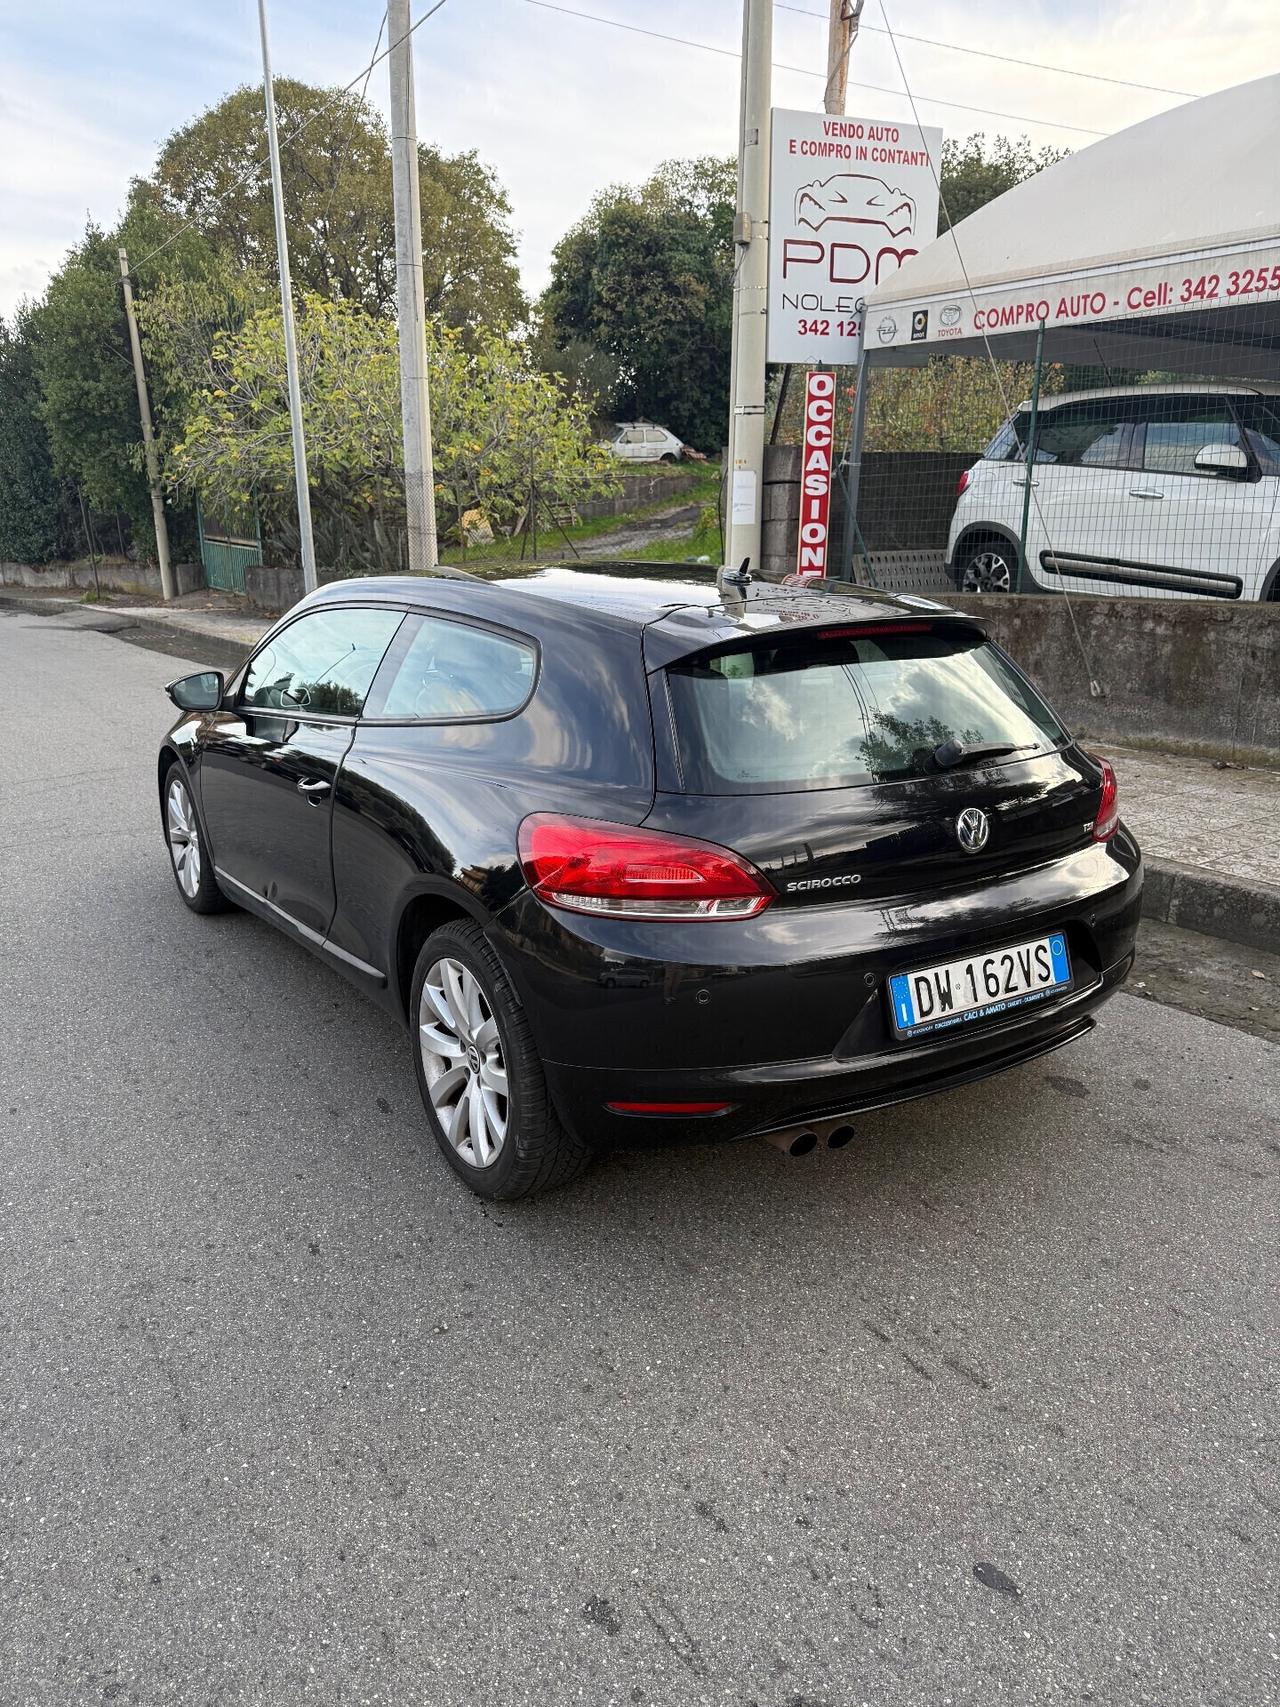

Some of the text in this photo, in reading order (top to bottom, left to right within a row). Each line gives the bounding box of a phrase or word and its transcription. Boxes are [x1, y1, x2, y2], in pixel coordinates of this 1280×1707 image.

[823, 120, 900, 143] VENDO AUTO
[789, 139, 930, 167] E COMPRO IN CONTANTI
[973, 299, 1050, 331] COMPRO
[1055, 291, 1106, 320] AUTO
[1126, 281, 1174, 311] Cell:
[1180, 273, 1220, 303] 342
[797, 319, 830, 337] 342
[938, 327, 963, 338] TOYOTA
[787, 874, 861, 893] SCIROCCO
[963, 1002, 1006, 1022] CACI & AMATO
